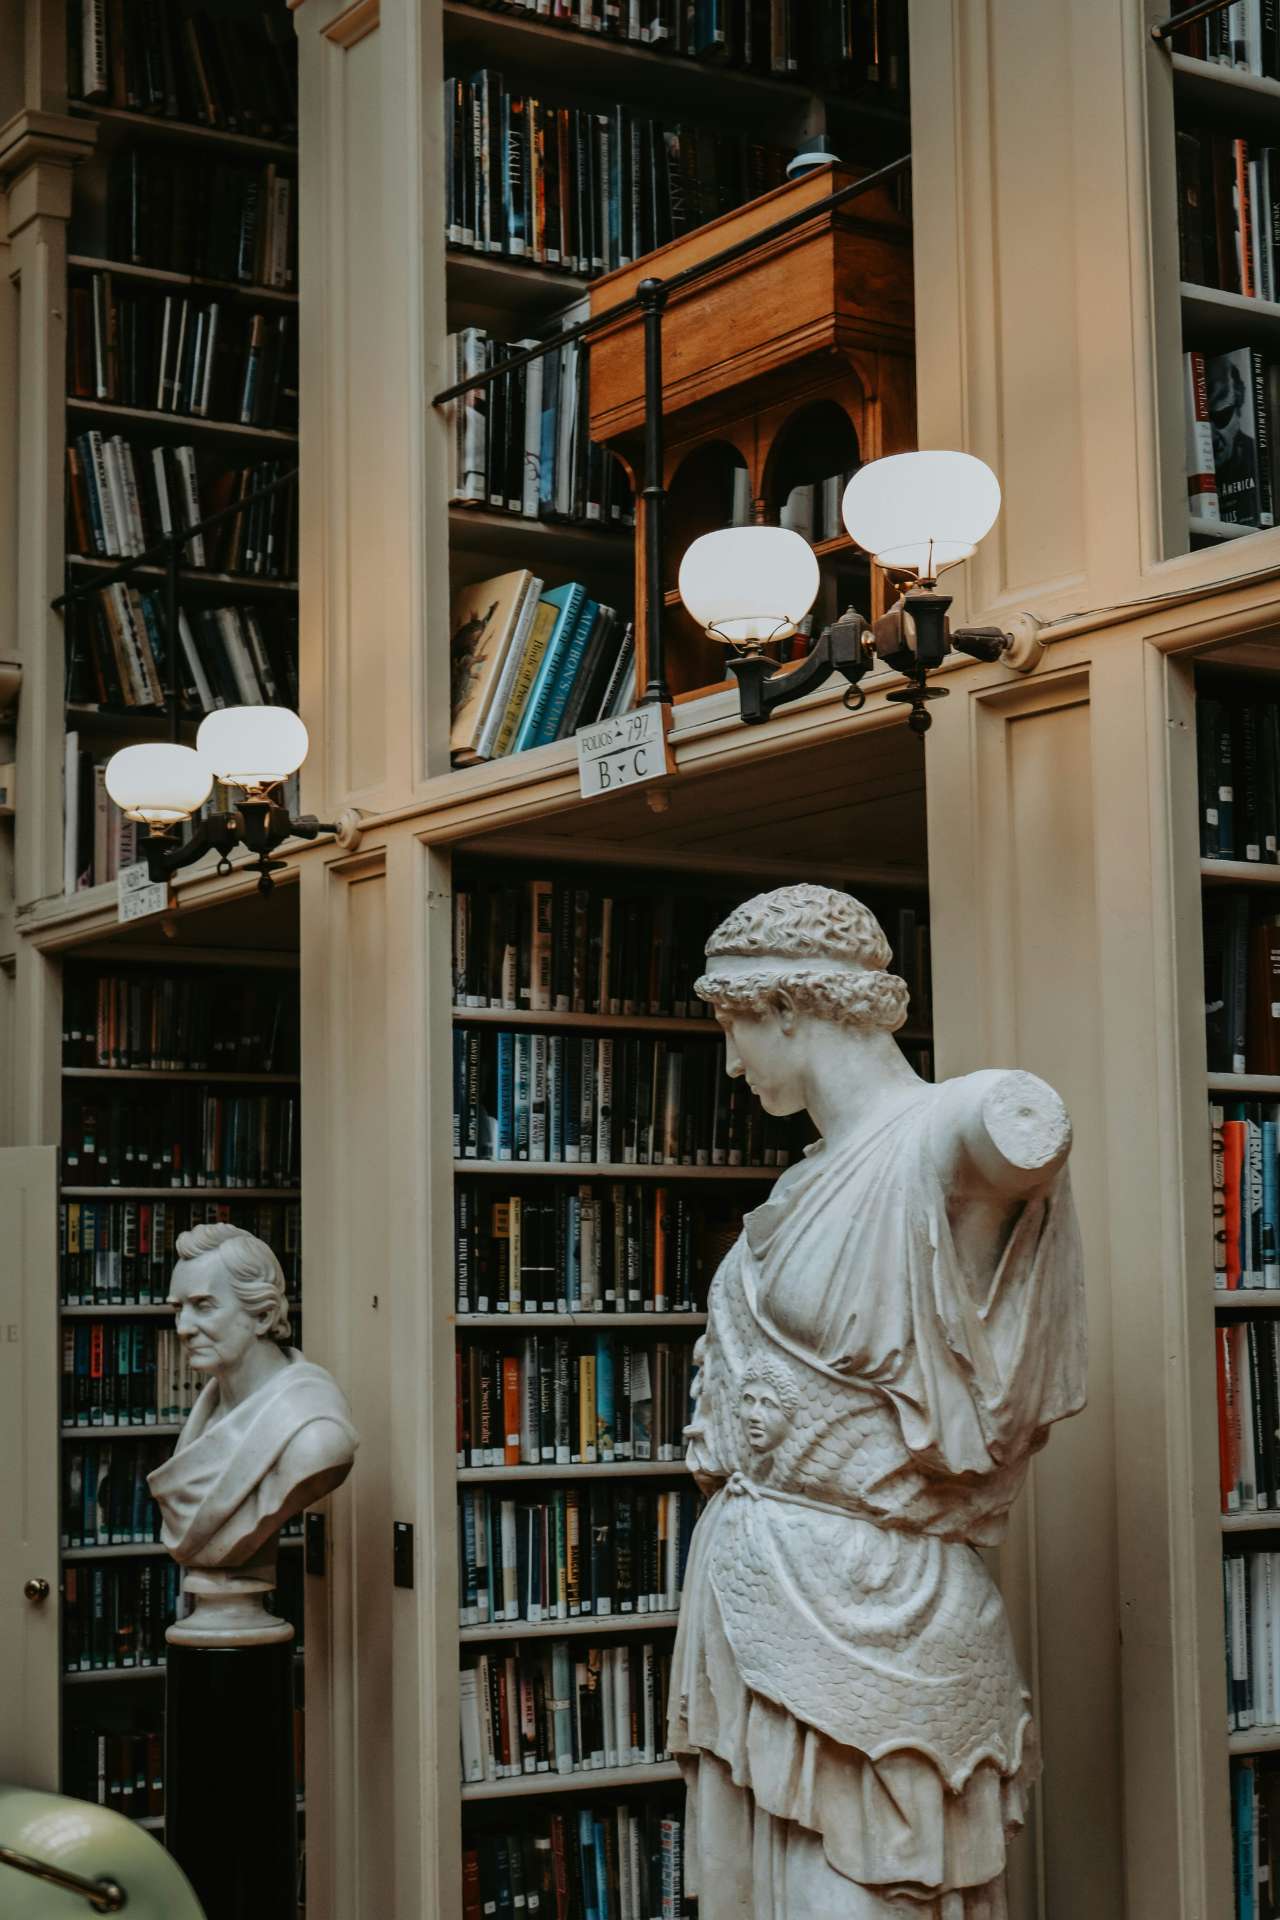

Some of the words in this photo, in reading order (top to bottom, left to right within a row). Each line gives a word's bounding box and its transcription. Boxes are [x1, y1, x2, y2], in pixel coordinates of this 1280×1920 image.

[526, 639, 545, 667] Birds
[582, 731, 613, 753] FOLIOS
[626, 714, 649, 743] 797
[598, 761, 611, 789] B
[634, 749, 648, 776] C
[469, 1039, 479, 1064] DAVID
[536, 1037, 546, 1061] DAVID
[583, 1042, 593, 1065] DAVID
[602, 1041, 613, 1065] DAVID
[469, 1066, 479, 1105] BALDACCI
[536, 1062, 546, 1099] BALDACCI
[583, 1066, 593, 1102] BALDACCI
[602, 1067, 612, 1105] BALDACCI
[1247, 1119, 1263, 1215] ARMADA
[622, 1356, 632, 1397] BANNISTER
